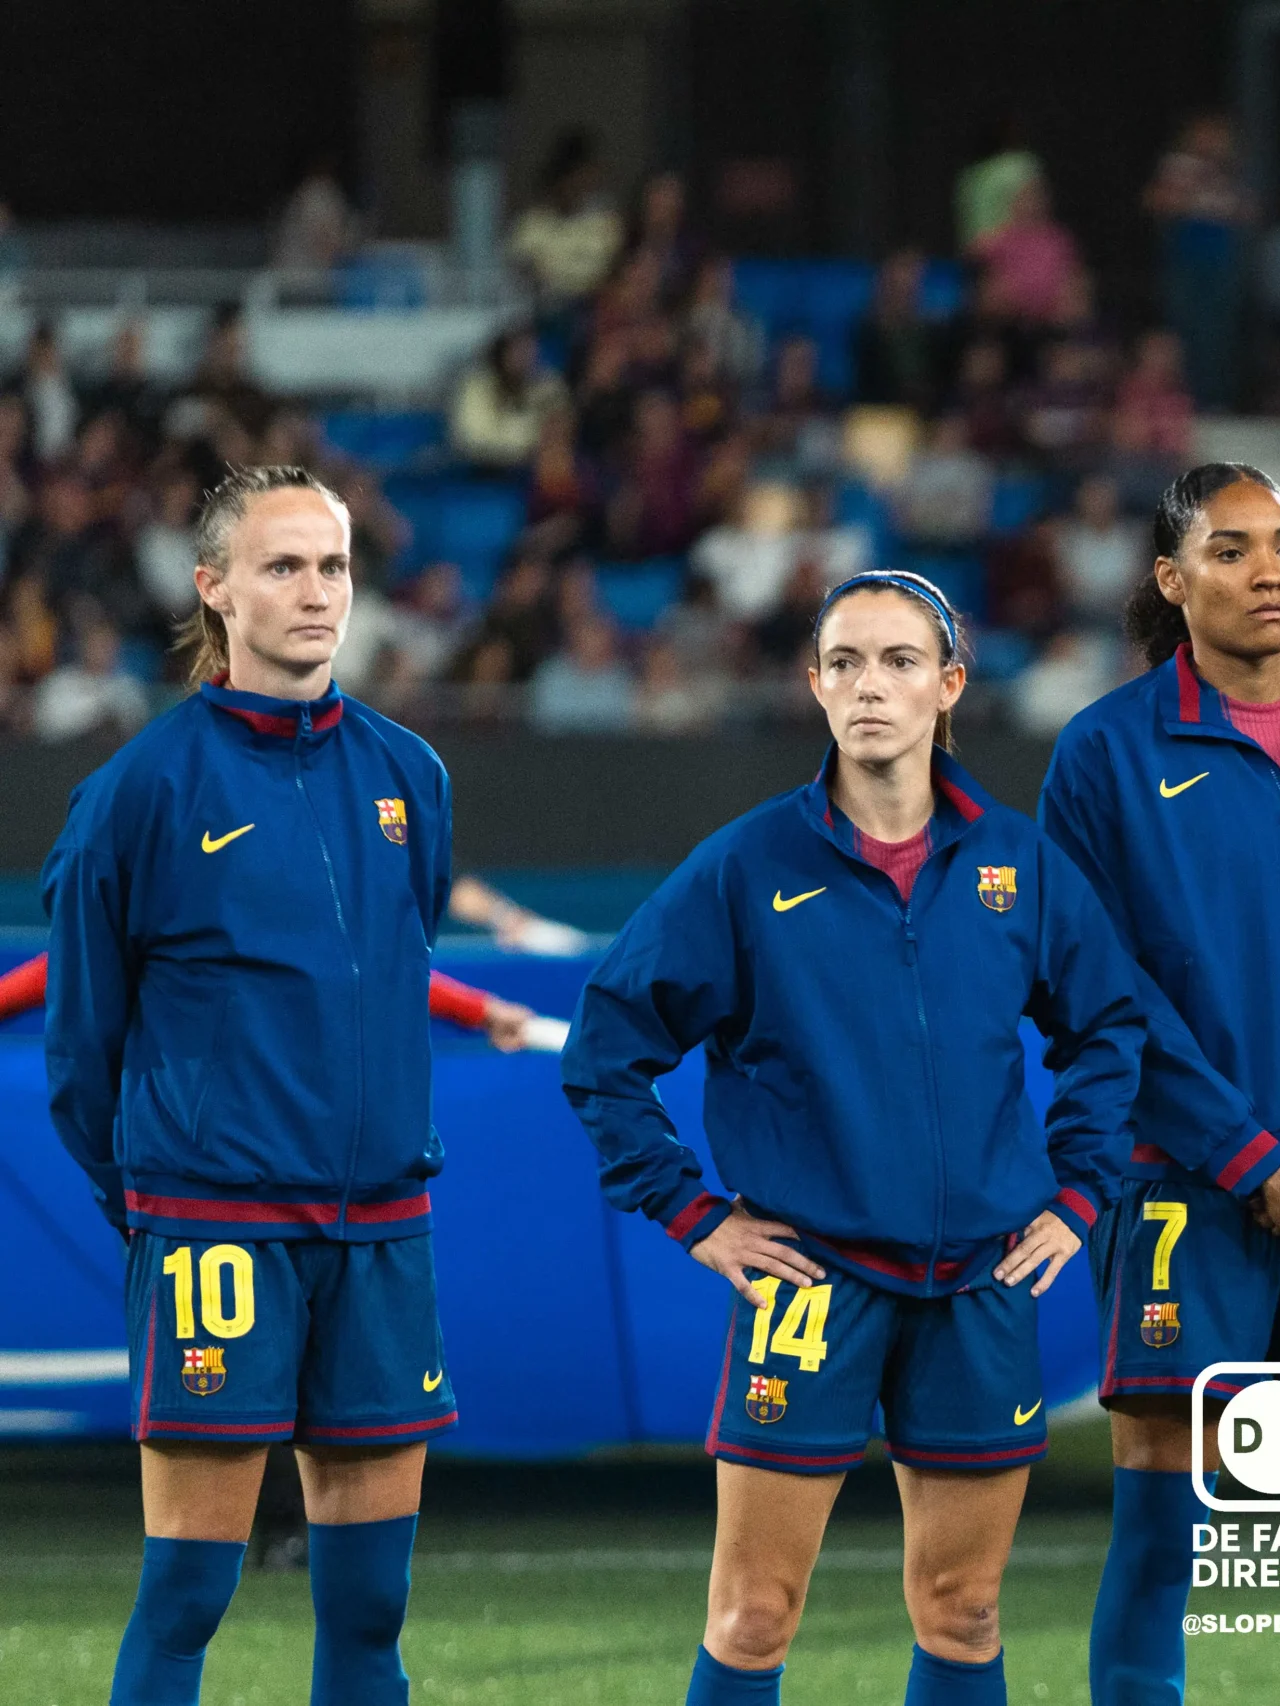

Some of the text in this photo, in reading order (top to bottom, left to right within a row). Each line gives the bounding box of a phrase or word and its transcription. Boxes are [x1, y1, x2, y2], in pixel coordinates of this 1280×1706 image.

[163, 1244, 255, 1339] 10
[1143, 1202, 1188, 1290] 7
[748, 1276, 832, 1372] 14
